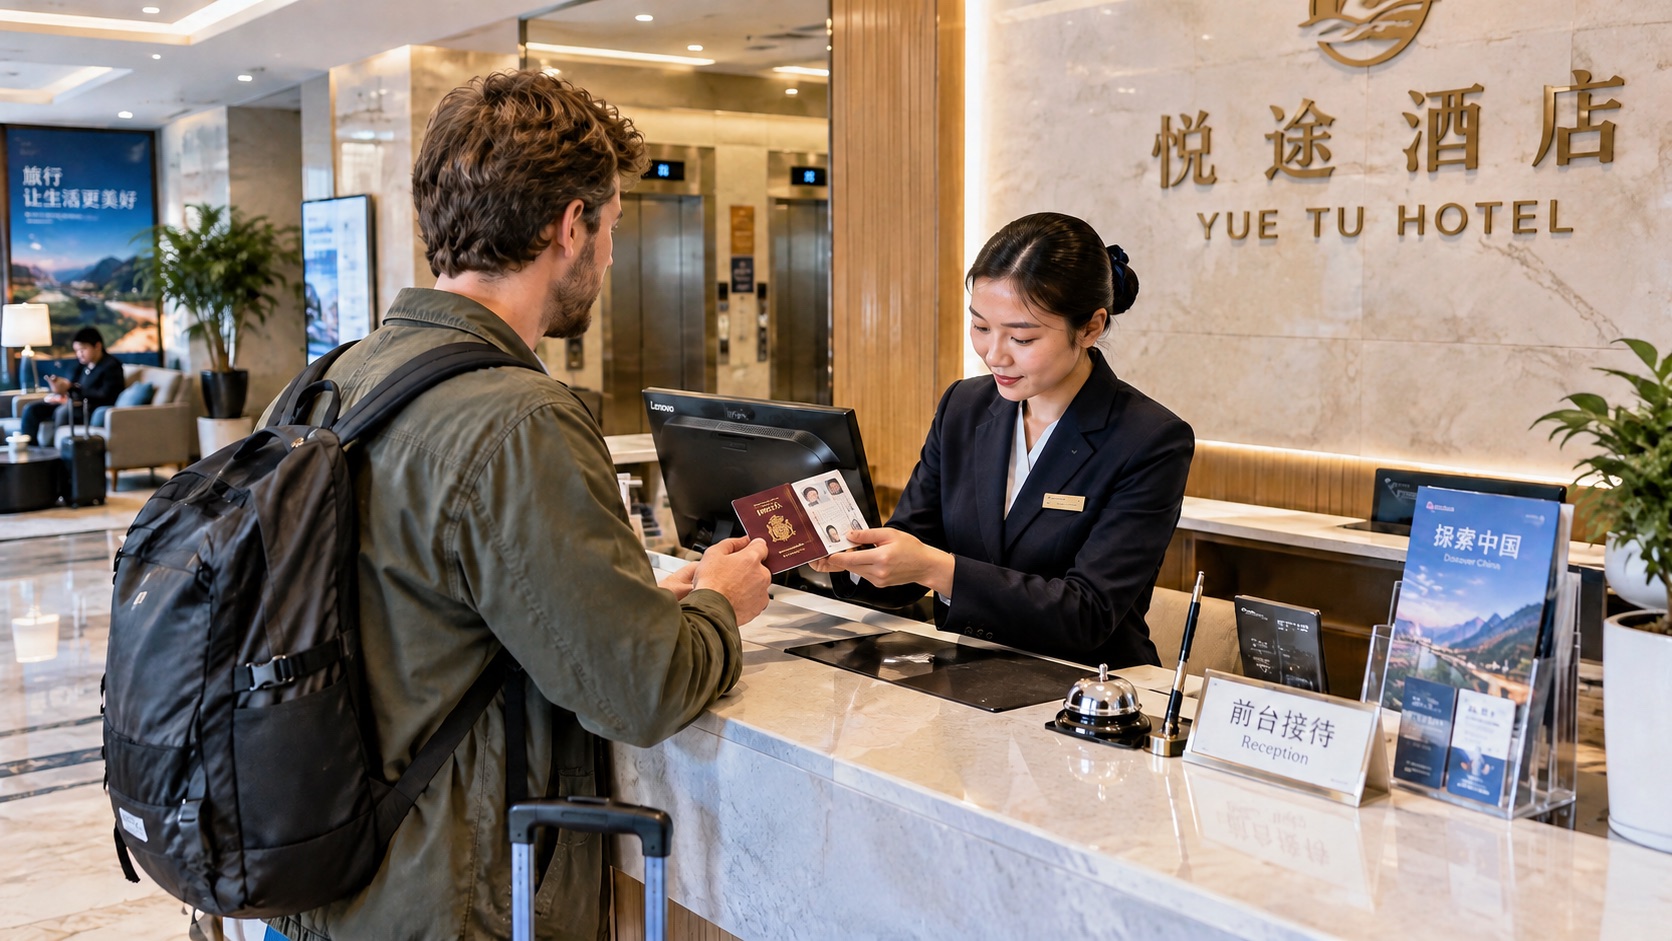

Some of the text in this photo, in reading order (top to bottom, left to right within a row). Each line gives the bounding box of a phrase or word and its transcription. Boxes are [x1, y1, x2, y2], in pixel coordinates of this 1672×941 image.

[1152, 69, 1625, 189] 悦途酒店
[23, 165, 63, 187] 旅行
[23, 187, 137, 210] 让生活更美好
[1197, 199, 1574, 239] YUE TU HOTEL
[650, 401, 674, 412] Lenovo
[1433, 524, 1521, 560] 探索中国
[1230, 698, 1336, 748] 前台接待
[1241, 734, 1309, 766] Reception
